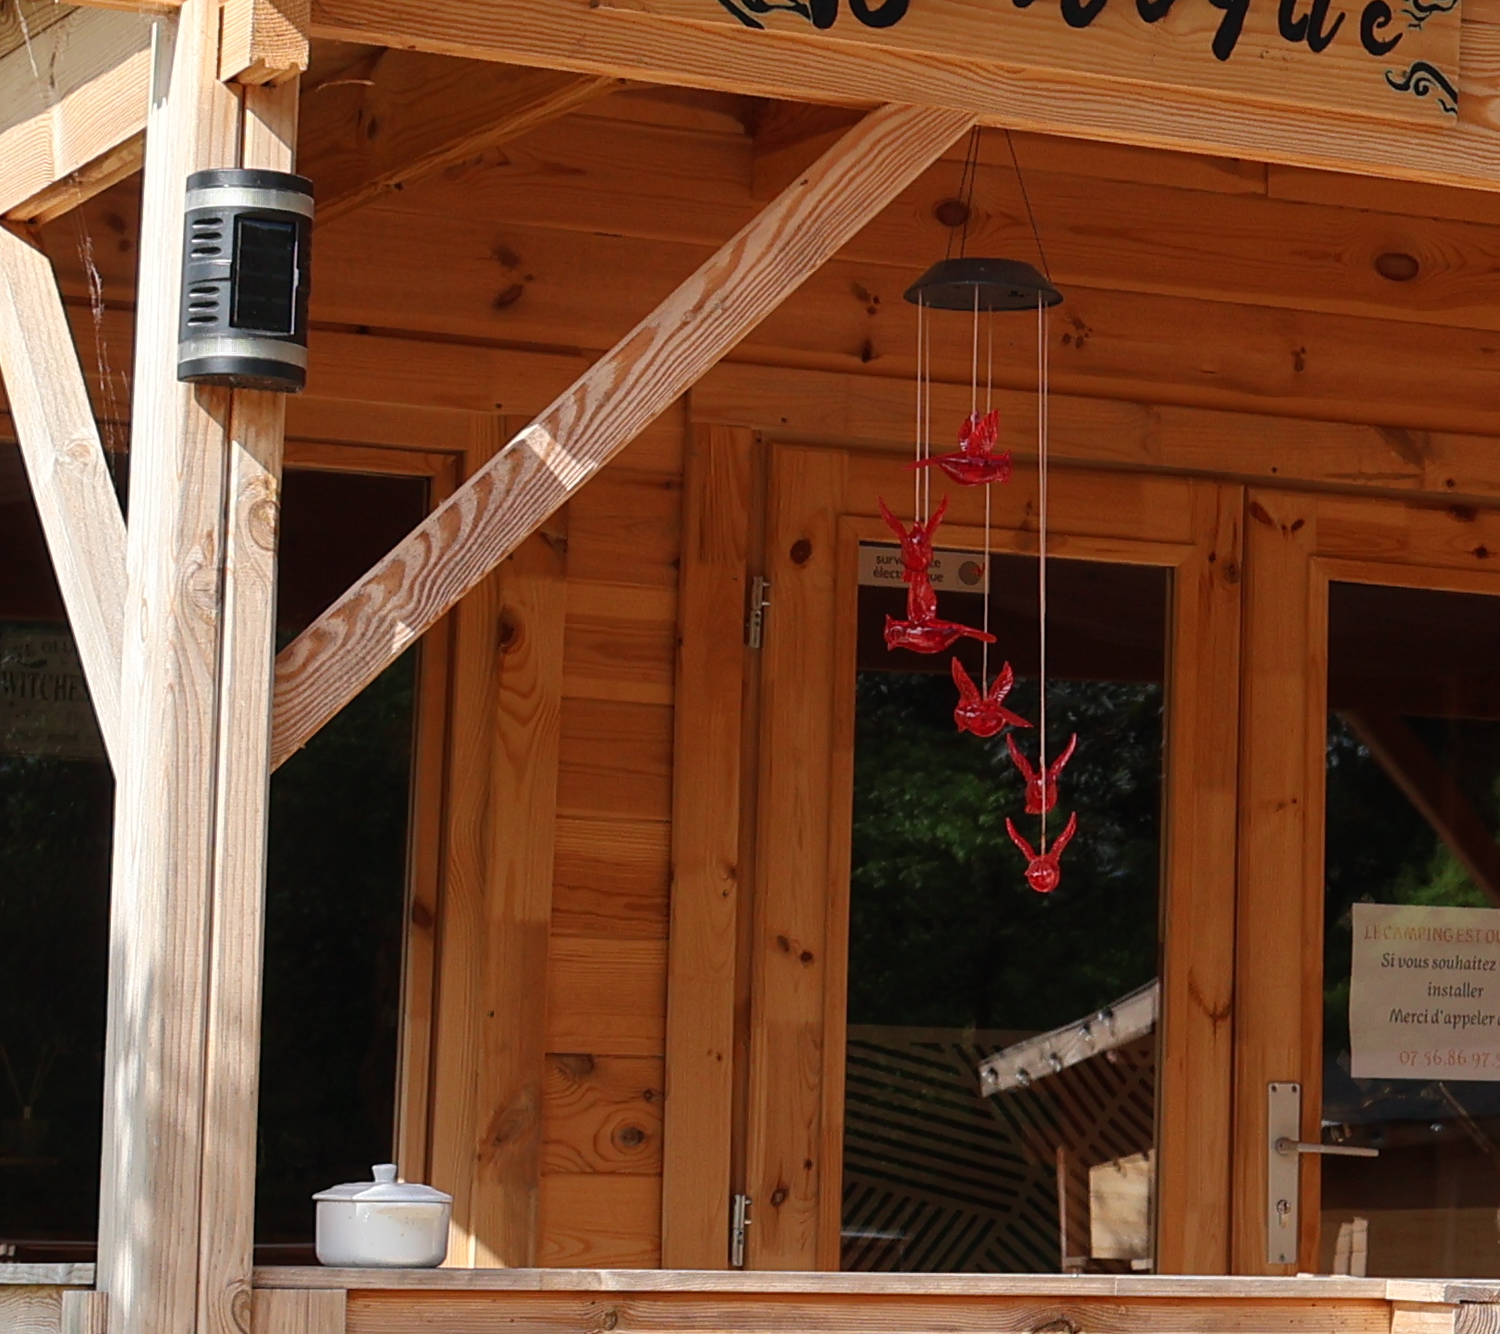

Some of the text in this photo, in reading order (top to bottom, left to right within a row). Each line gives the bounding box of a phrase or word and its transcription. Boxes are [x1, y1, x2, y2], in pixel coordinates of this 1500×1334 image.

[1364, 924, 1381, 940] LE
[1383, 924, 1454, 943] CAMPING
[1456, 928, 1483, 943] EST
[1381, 952, 1395, 968] Si
[1398, 957, 1429, 969] vous
[1431, 954, 1496, 971] souhaitez
[1428, 981, 1485, 998] installer
[1389, 1009, 1428, 1024] Merci
[1431, 1009, 1495, 1030] d'appeler
